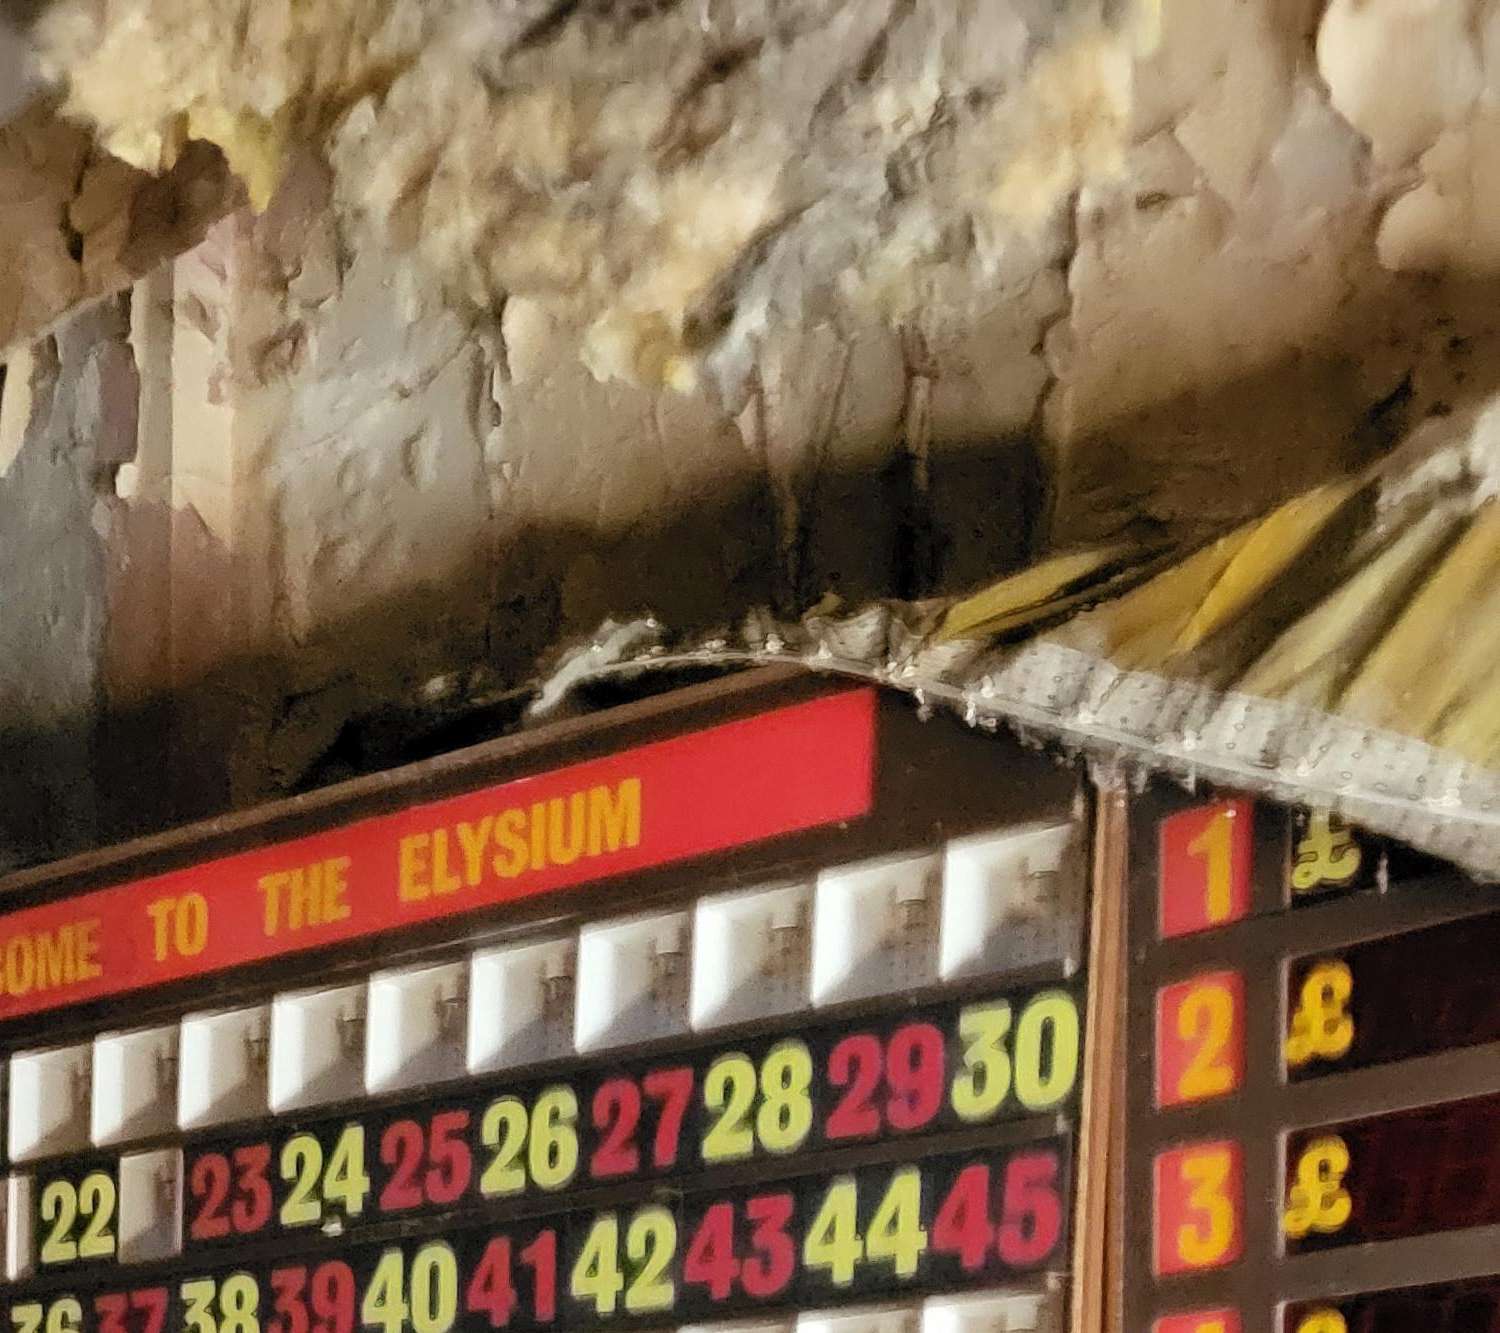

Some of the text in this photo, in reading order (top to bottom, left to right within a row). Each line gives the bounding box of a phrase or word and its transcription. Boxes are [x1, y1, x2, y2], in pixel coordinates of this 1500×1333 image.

[148, 893, 208, 961] TO
[259, 857, 351, 936] THE
[399, 778, 642, 901] ELYSIUM
[1190, 808, 1232, 922] 1
[1176, 960, 1353, 1097] 2 £
[42, 991, 1079, 1262] 22 23 24 25 26 27 28 29 30
[1177, 1134, 1351, 1266] 3 £
[467, 1229, 556, 1325] 41
[571, 1205, 677, 1312] 42
[684, 1192, 794, 1299] 43
[805, 1166, 926, 1287] 44
[933, 1151, 1061, 1267] 45
